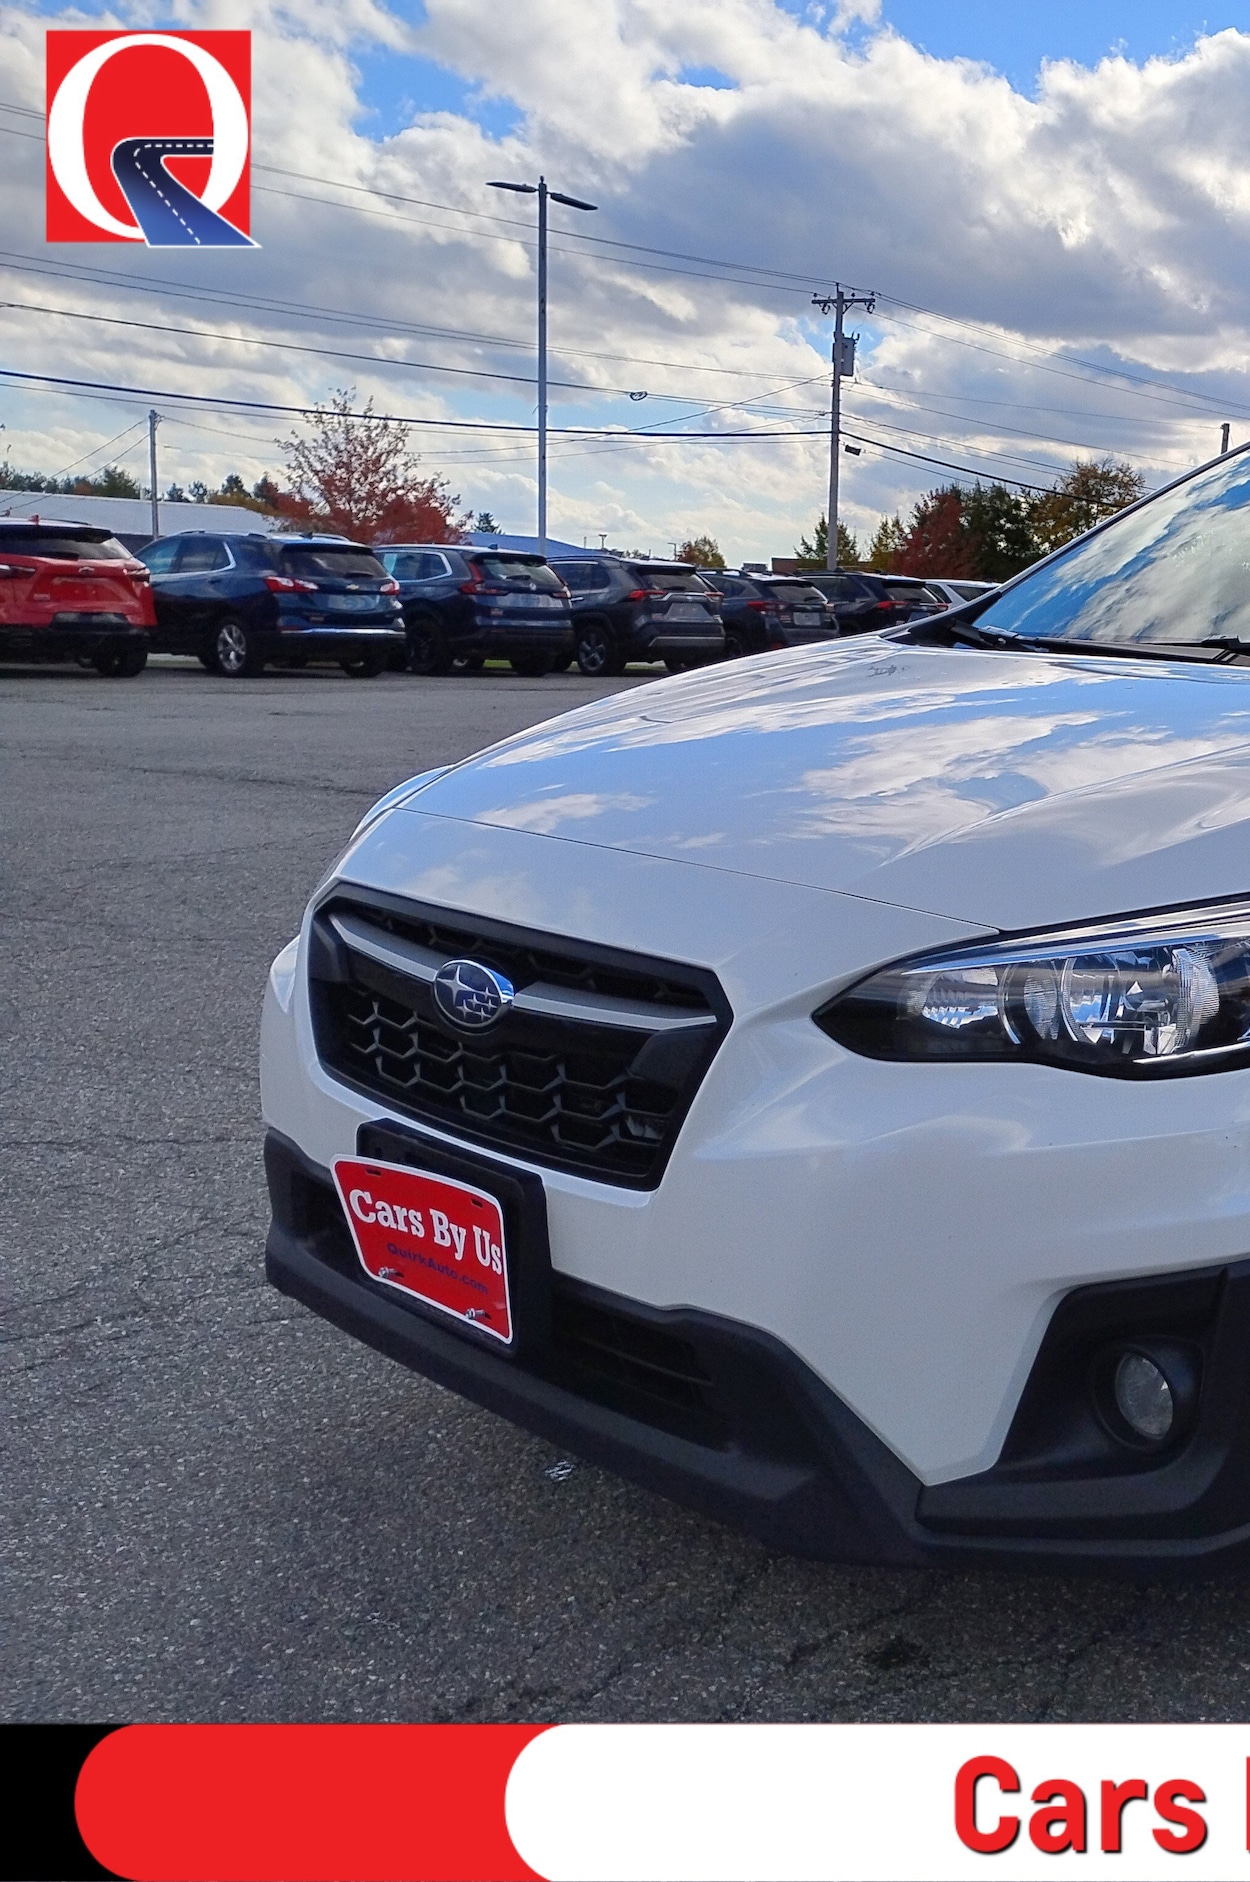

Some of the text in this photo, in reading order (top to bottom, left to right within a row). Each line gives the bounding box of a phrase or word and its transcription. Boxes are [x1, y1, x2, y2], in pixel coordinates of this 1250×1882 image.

[350, 1189, 502, 1275] Cars By Us
[387, 1243, 489, 1294] QuirkAuto.com
